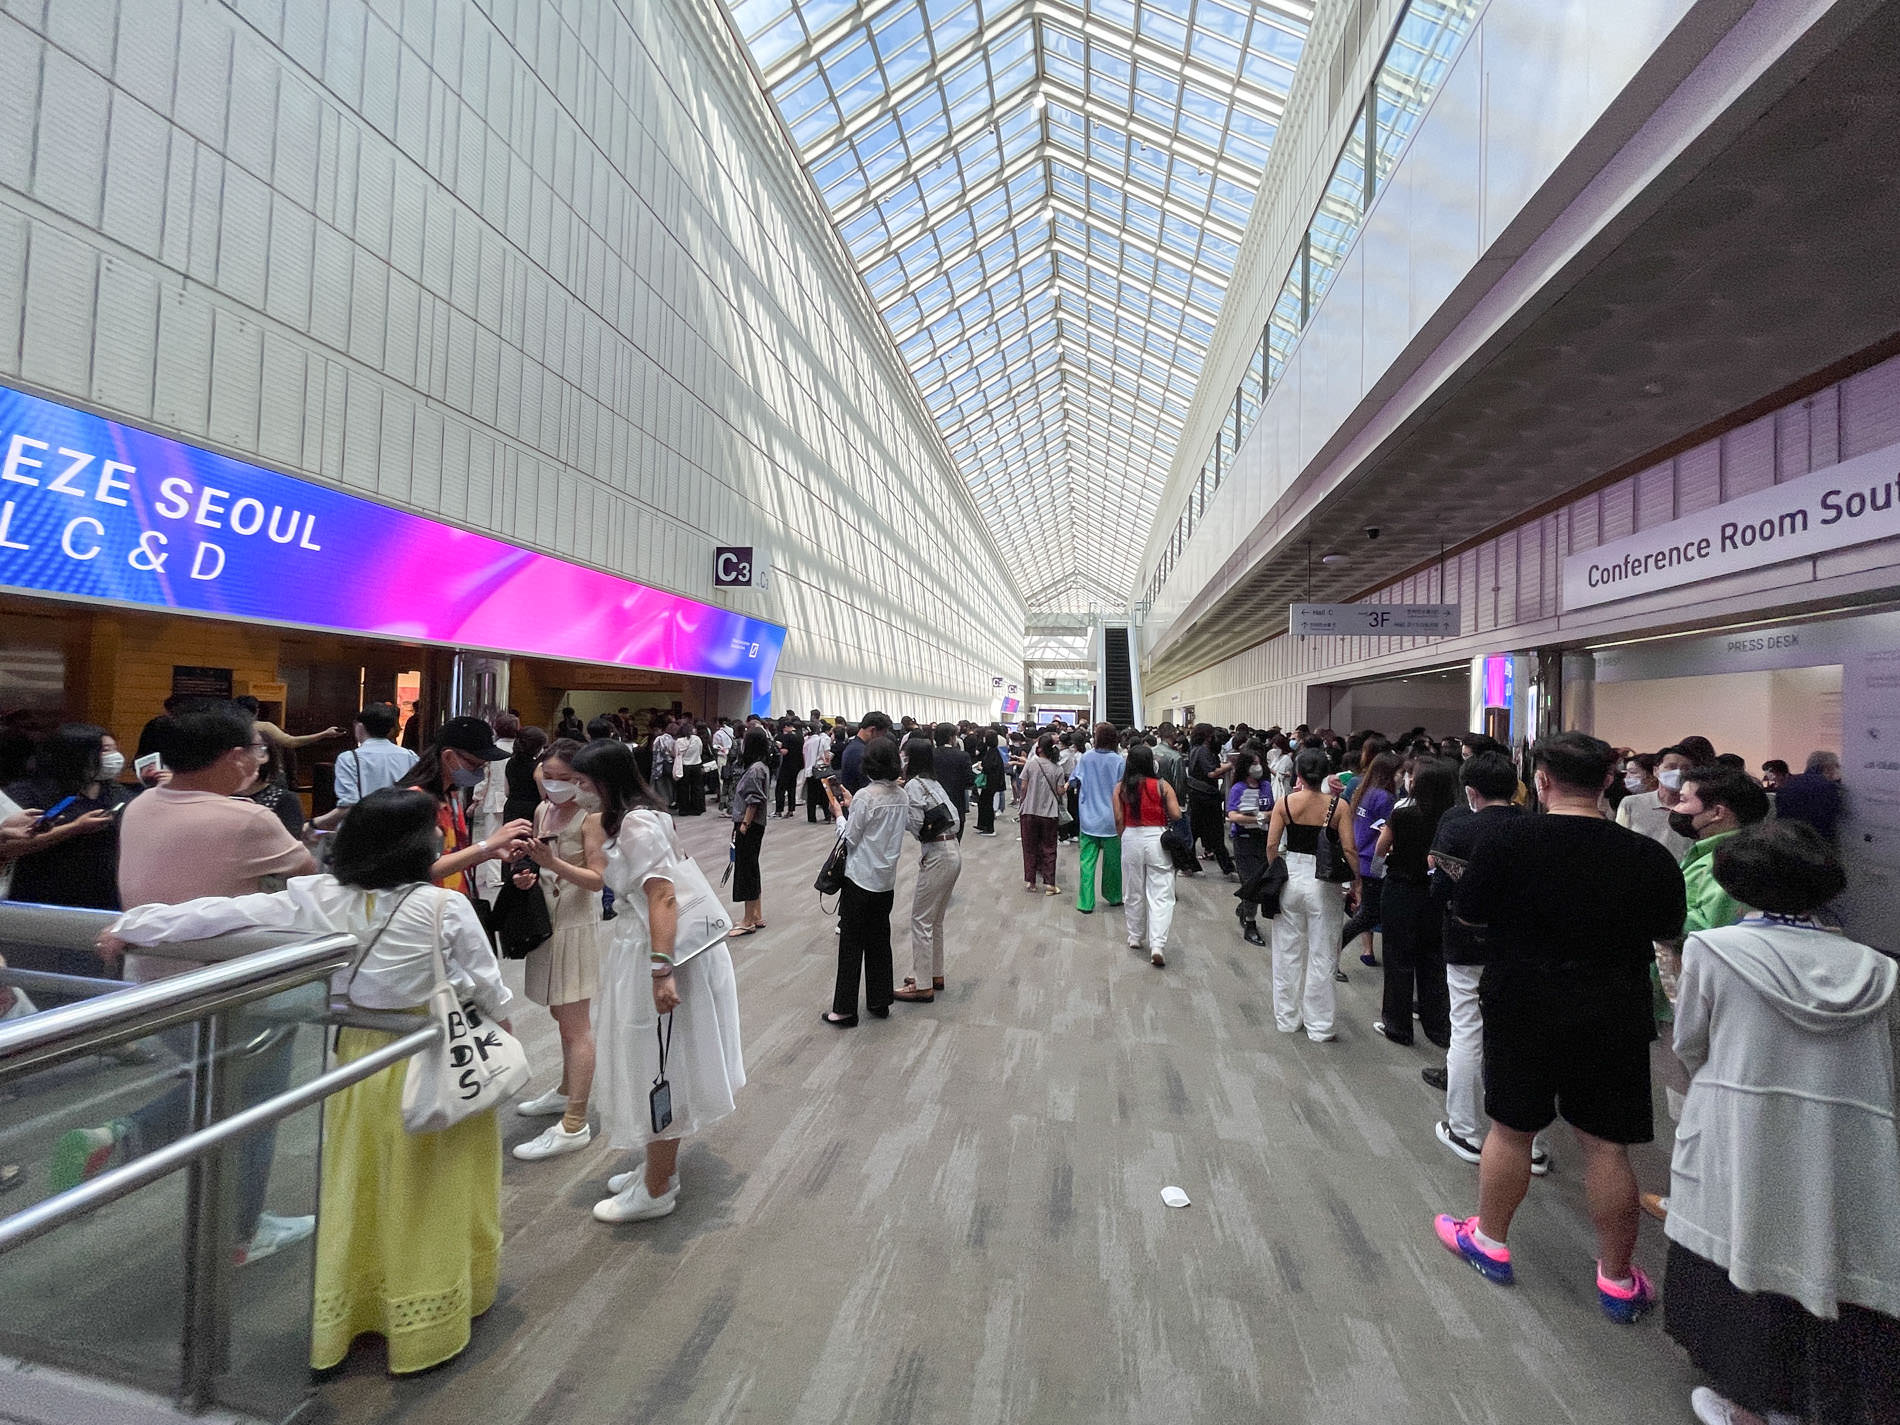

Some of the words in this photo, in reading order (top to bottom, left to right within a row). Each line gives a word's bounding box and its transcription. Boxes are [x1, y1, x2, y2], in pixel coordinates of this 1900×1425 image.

[155, 477, 321, 551] SEOUL
[61, 516, 105, 560] C
[128, 530, 168, 573] &
[190, 541, 226, 580] D
[717, 552, 751, 582] C3
[1588, 537, 1711, 588] Conference
[1720, 508, 1808, 552] Room
[1369, 611, 1391, 628] 3F
[1727, 638, 1764, 653] PRESS
[1767, 633, 1799, 649] DESK
